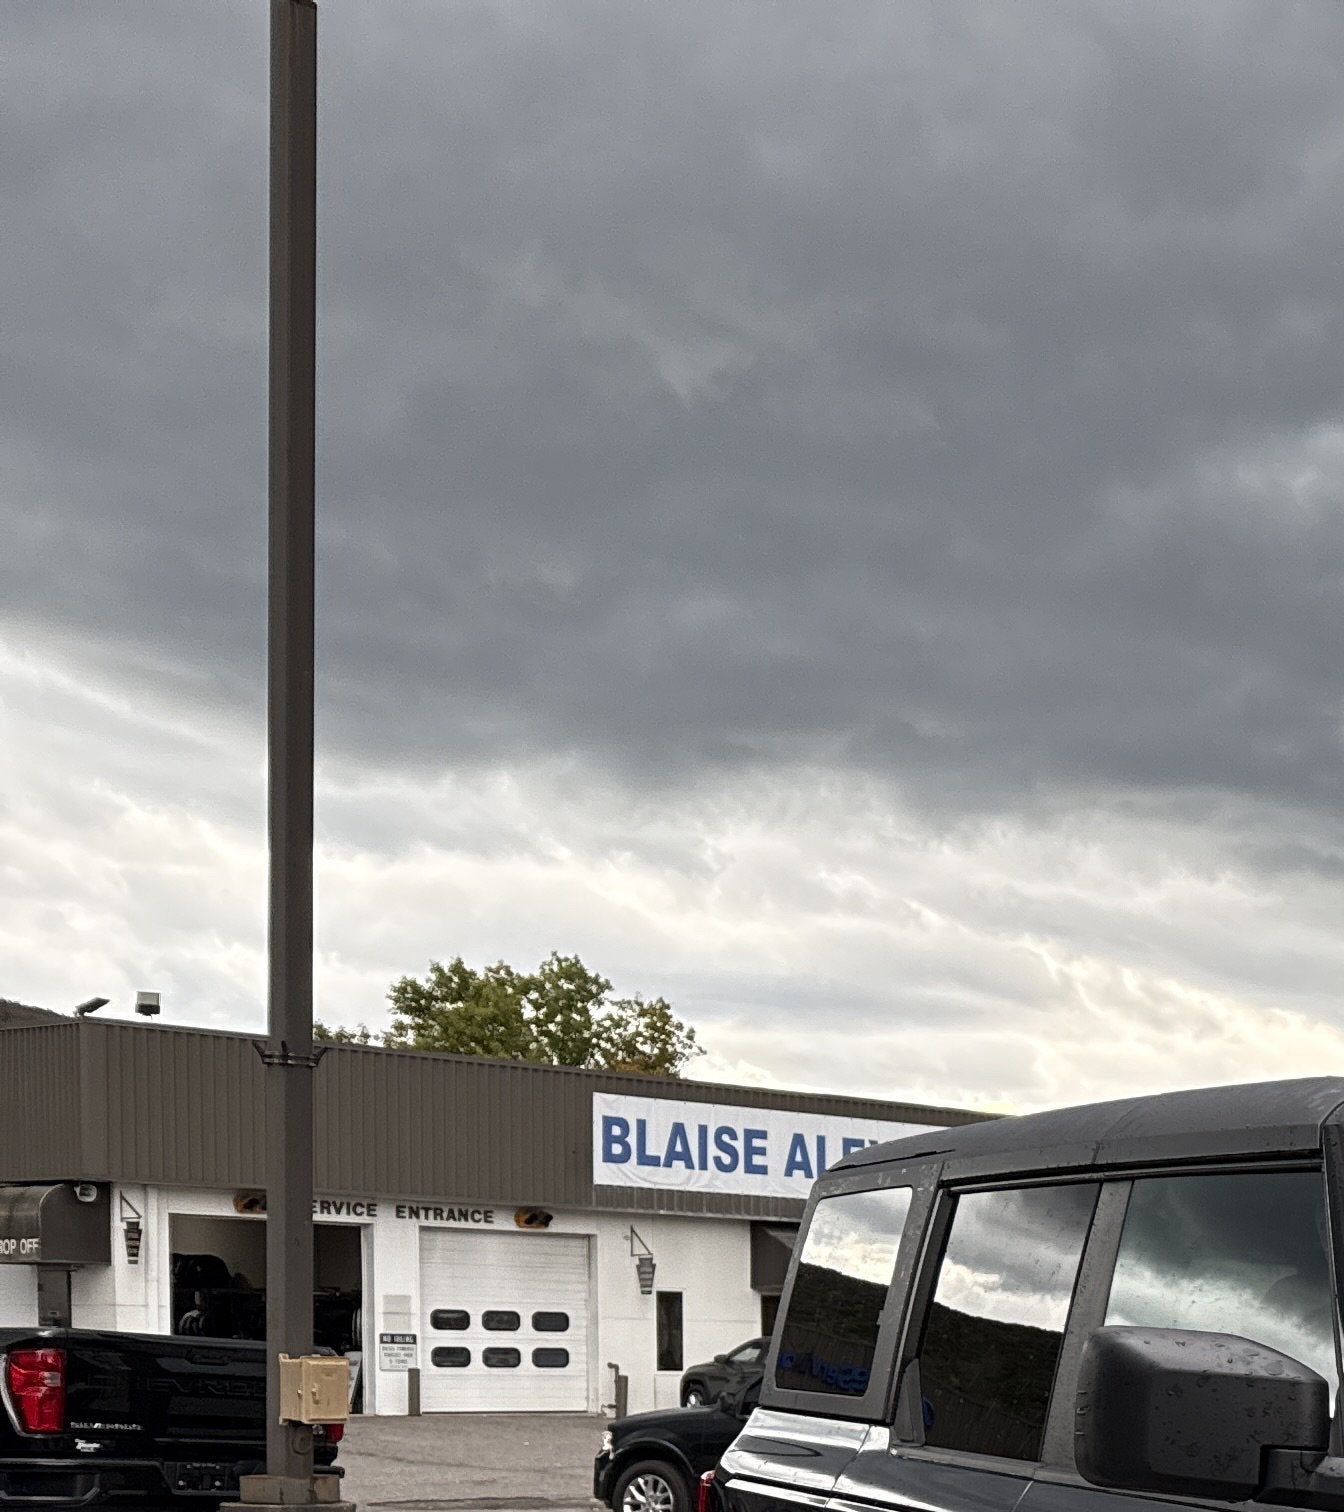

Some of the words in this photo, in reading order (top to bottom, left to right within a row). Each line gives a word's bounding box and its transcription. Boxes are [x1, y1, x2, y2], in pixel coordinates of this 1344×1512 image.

[601, 1114, 769, 1177] BLAISE
[312, 1200, 378, 1217] ERVICE
[395, 1204, 495, 1224] ENTRANCE
[20, 1237, 40, 1255] OFF
